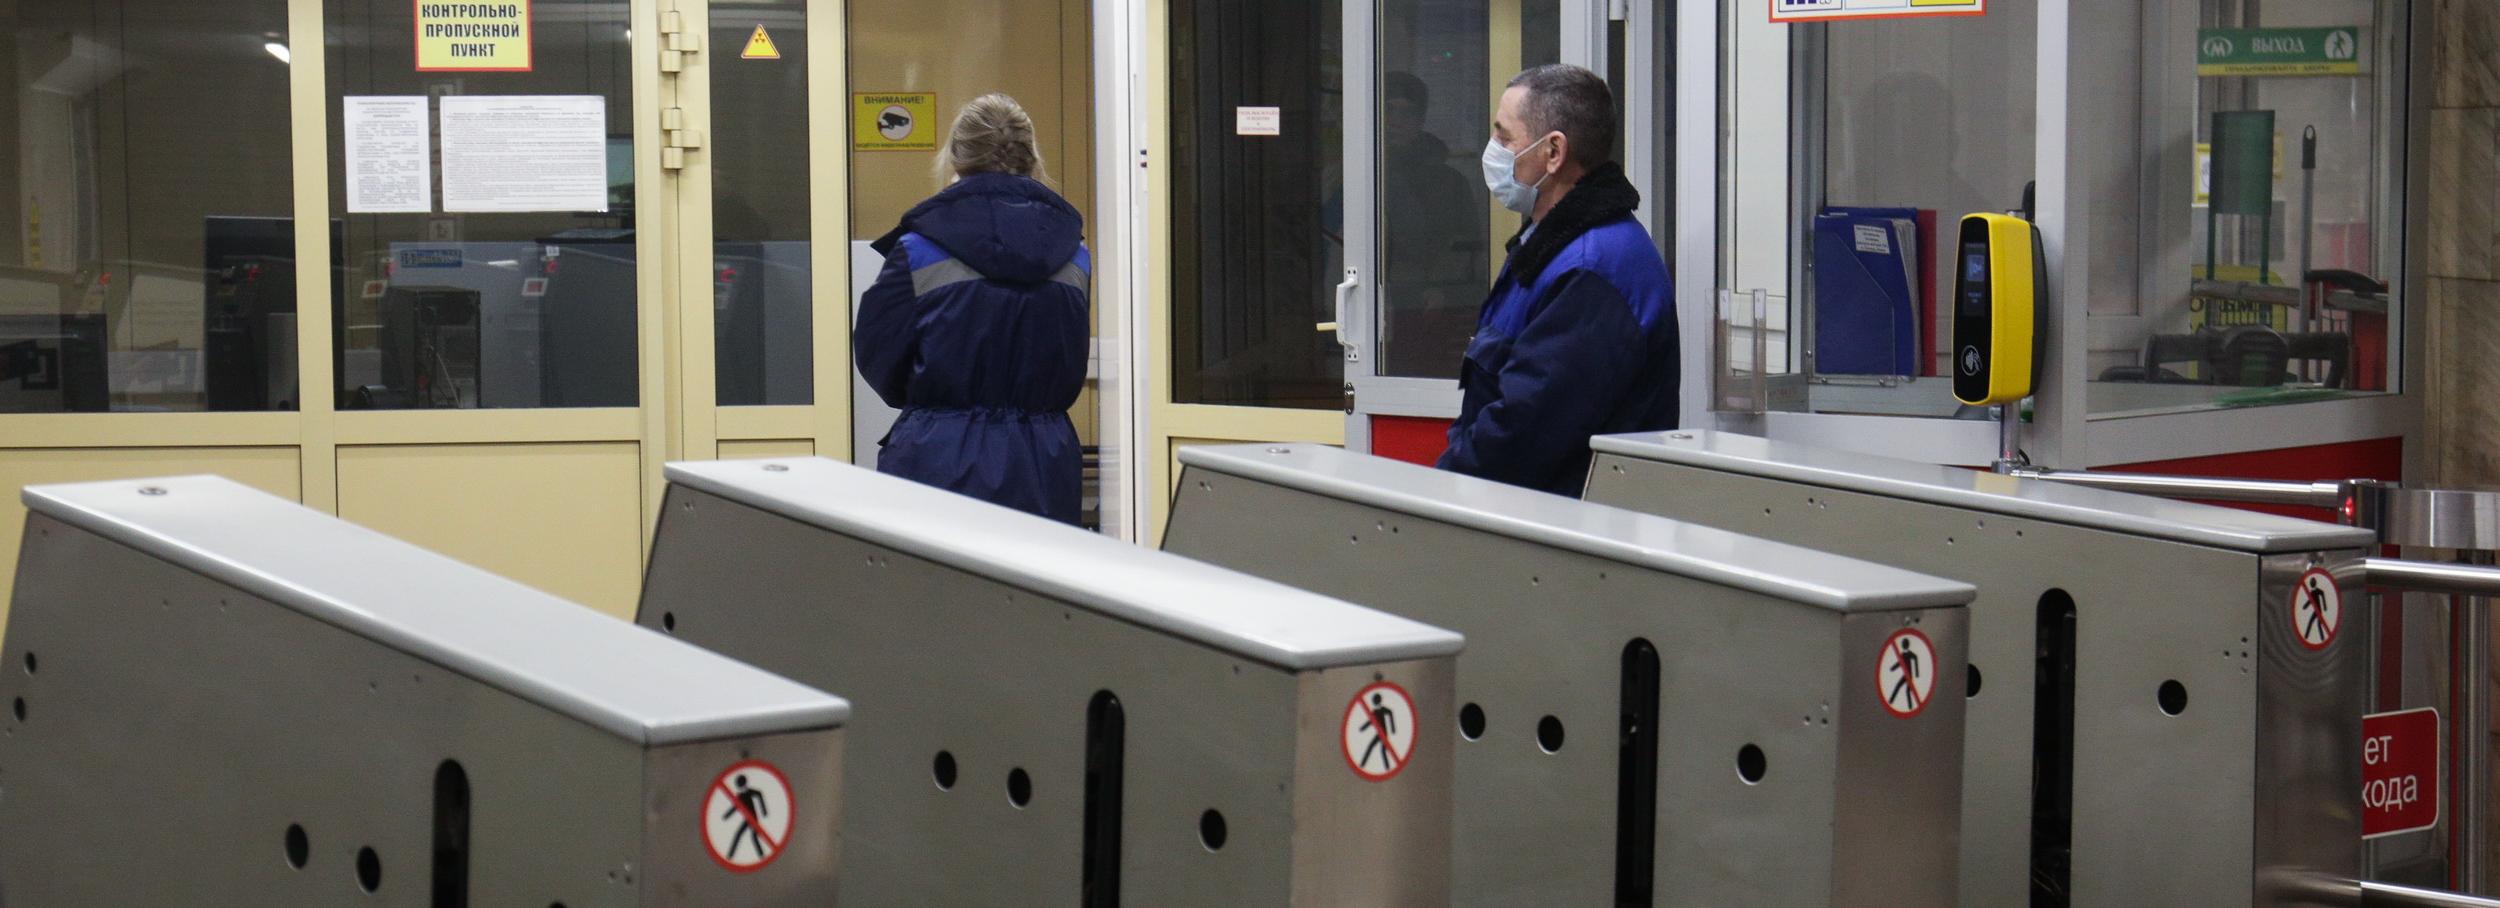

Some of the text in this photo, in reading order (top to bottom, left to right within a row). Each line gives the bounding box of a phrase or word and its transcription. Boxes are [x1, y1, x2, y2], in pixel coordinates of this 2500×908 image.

[422, 4, 522, 18] КОНТРОЛЬНО-
[425, 21, 519, 38] ПРОПУСКНОЙ
[451, 43, 495, 57] ПУНКТ
[2252, 37, 2305, 53] ВЫХОД
[863, 95, 924, 105] ВНИМАНИЕ!
[2364, 735, 2392, 765] ет
[2362, 774, 2418, 812] хода
